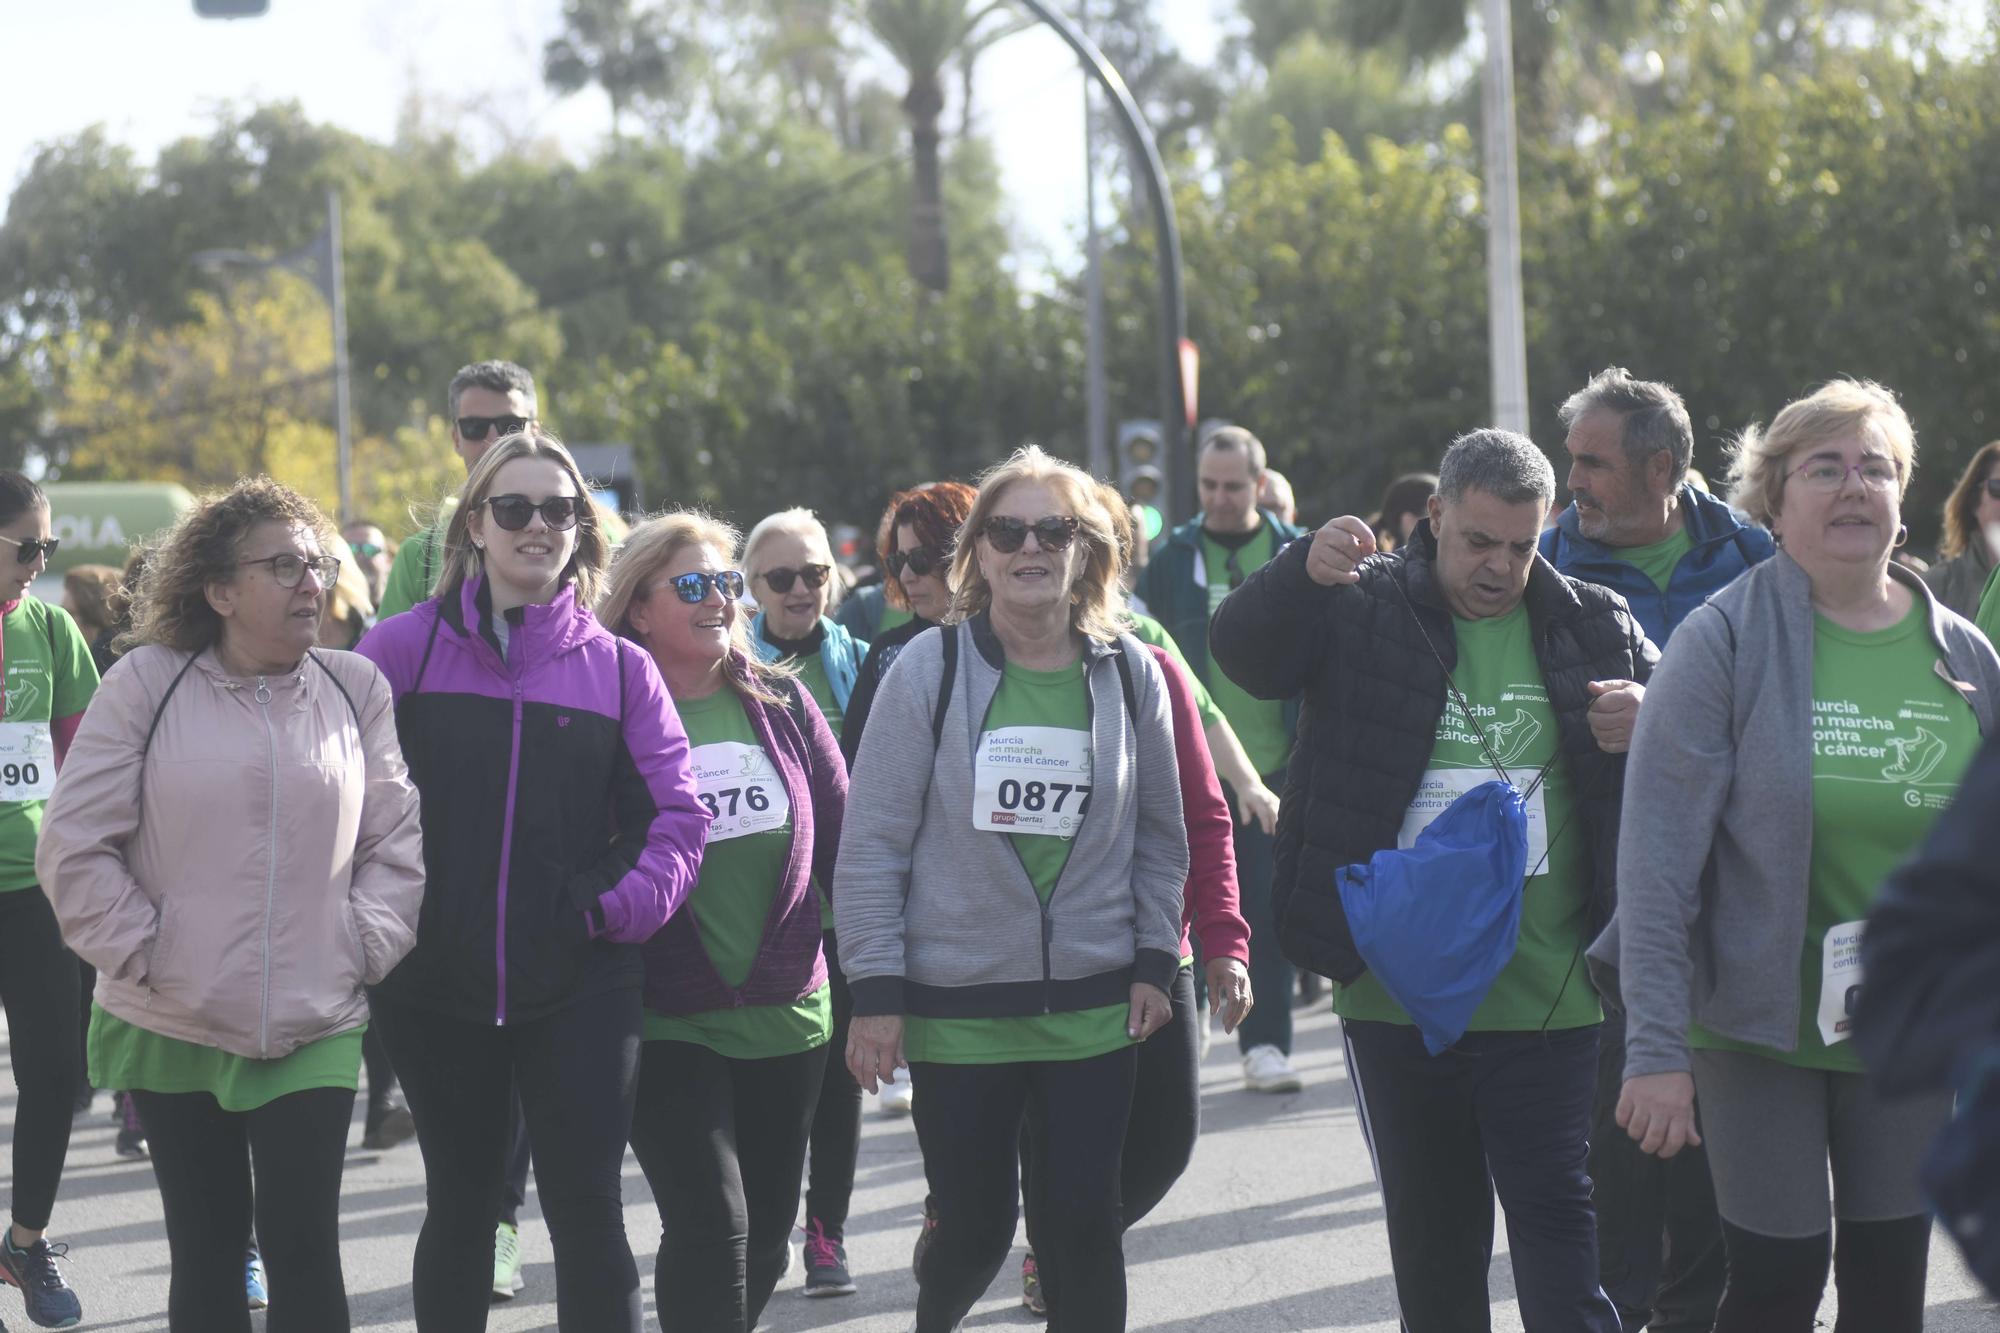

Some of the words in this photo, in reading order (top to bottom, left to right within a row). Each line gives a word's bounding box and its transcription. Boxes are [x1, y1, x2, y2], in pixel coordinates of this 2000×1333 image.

[1812, 699, 1860, 714] urcia
[1828, 715, 1895, 731] marcha
[990, 736, 1024, 745] Murcia
[1004, 745, 1043, 755] marcha
[1824, 742, 1887, 758] cáncer
[988, 754, 1022, 763] contra
[1024, 755, 1033, 764] el
[0, 763, 40, 786] 90
[697, 768, 730, 779] cáncer
[998, 779, 1093, 815] 0877
